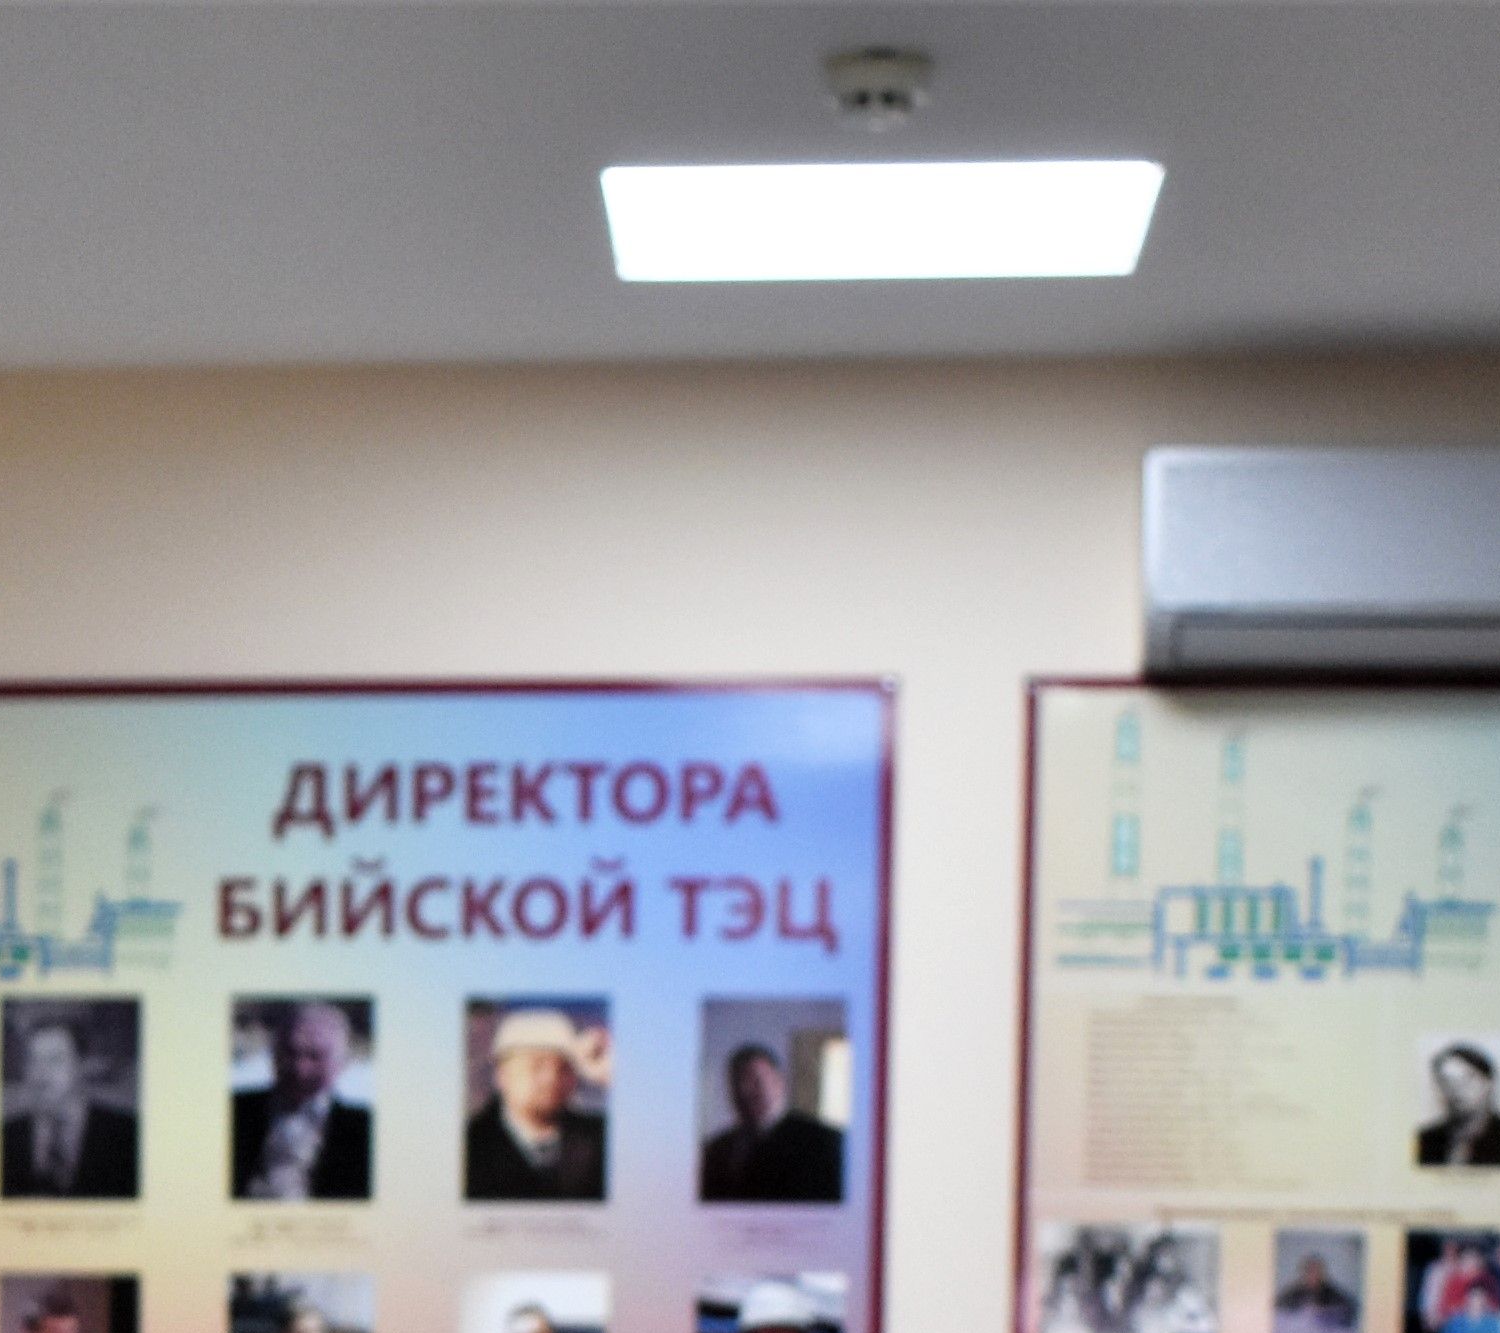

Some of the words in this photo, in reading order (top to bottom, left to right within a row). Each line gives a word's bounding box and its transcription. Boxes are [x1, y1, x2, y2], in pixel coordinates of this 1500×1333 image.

[271, 761, 781, 842] ДИРЕКТОРА
[216, 857, 637, 941] БИЙСКОЙ
[667, 876, 837, 955] ТЭЦ
